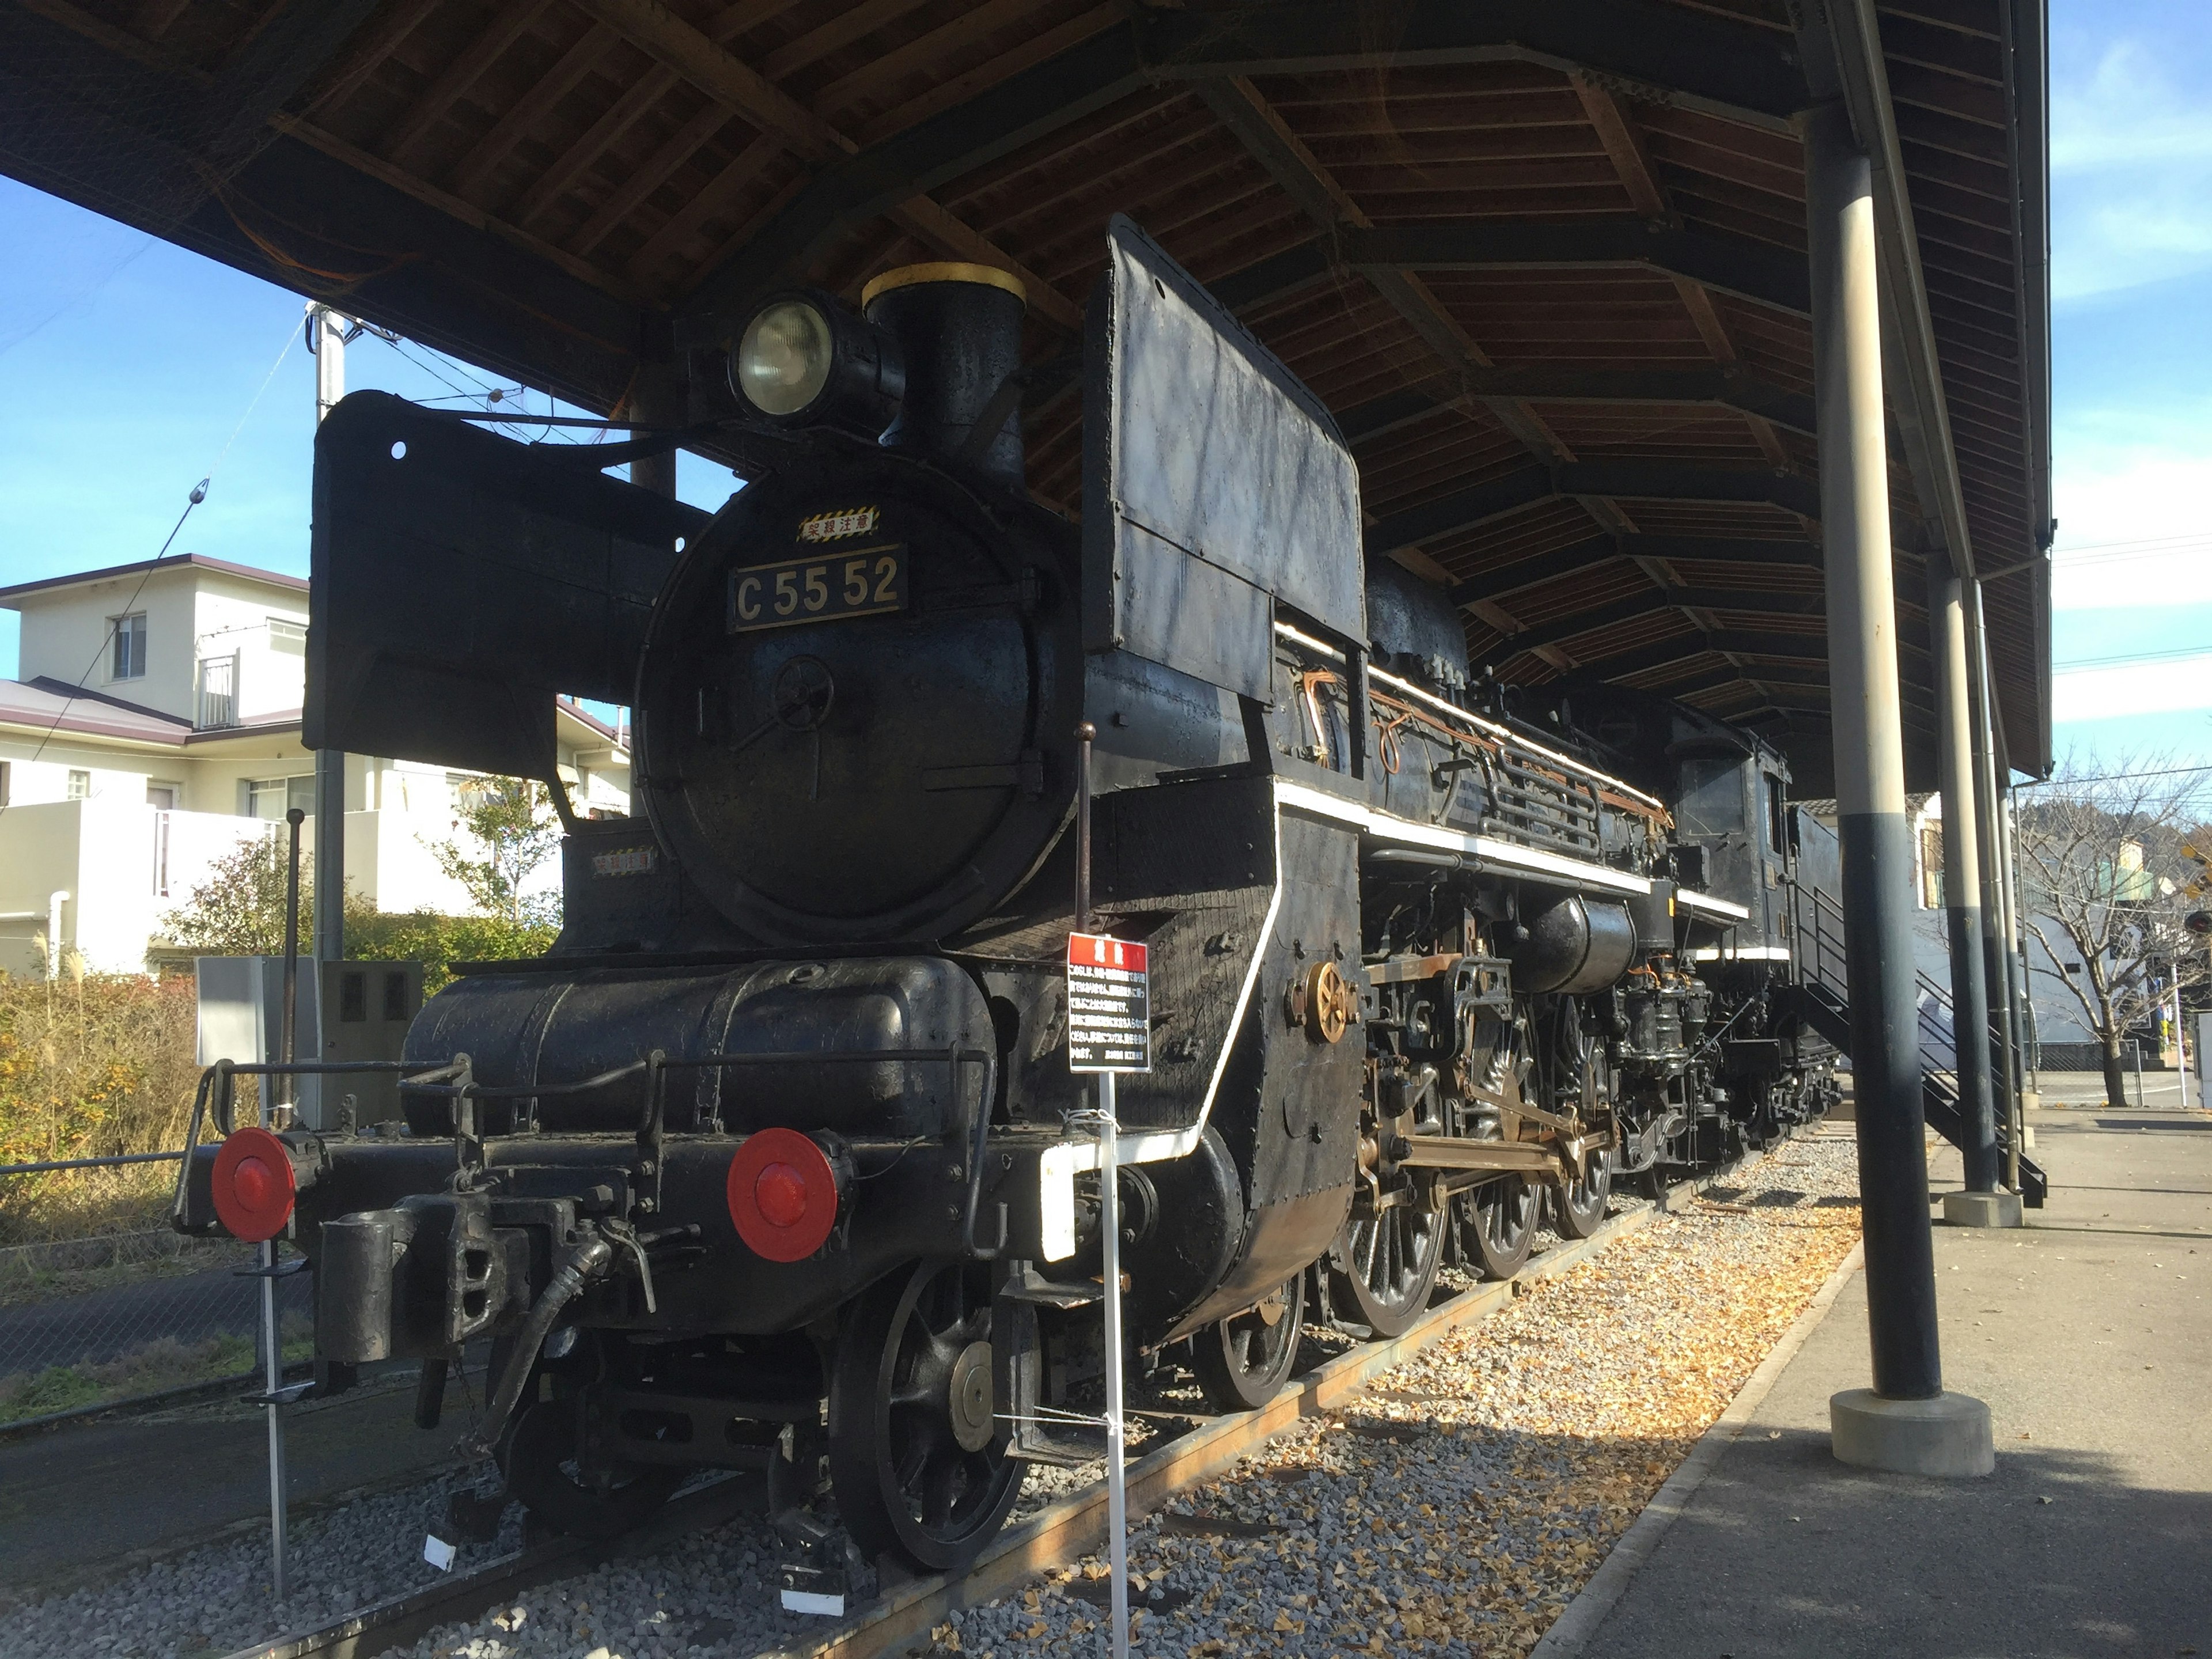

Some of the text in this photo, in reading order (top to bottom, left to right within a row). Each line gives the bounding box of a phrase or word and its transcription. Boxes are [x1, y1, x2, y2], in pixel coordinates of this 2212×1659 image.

[808, 514, 869, 537] 架線注意
[843, 556, 897, 606] 52
